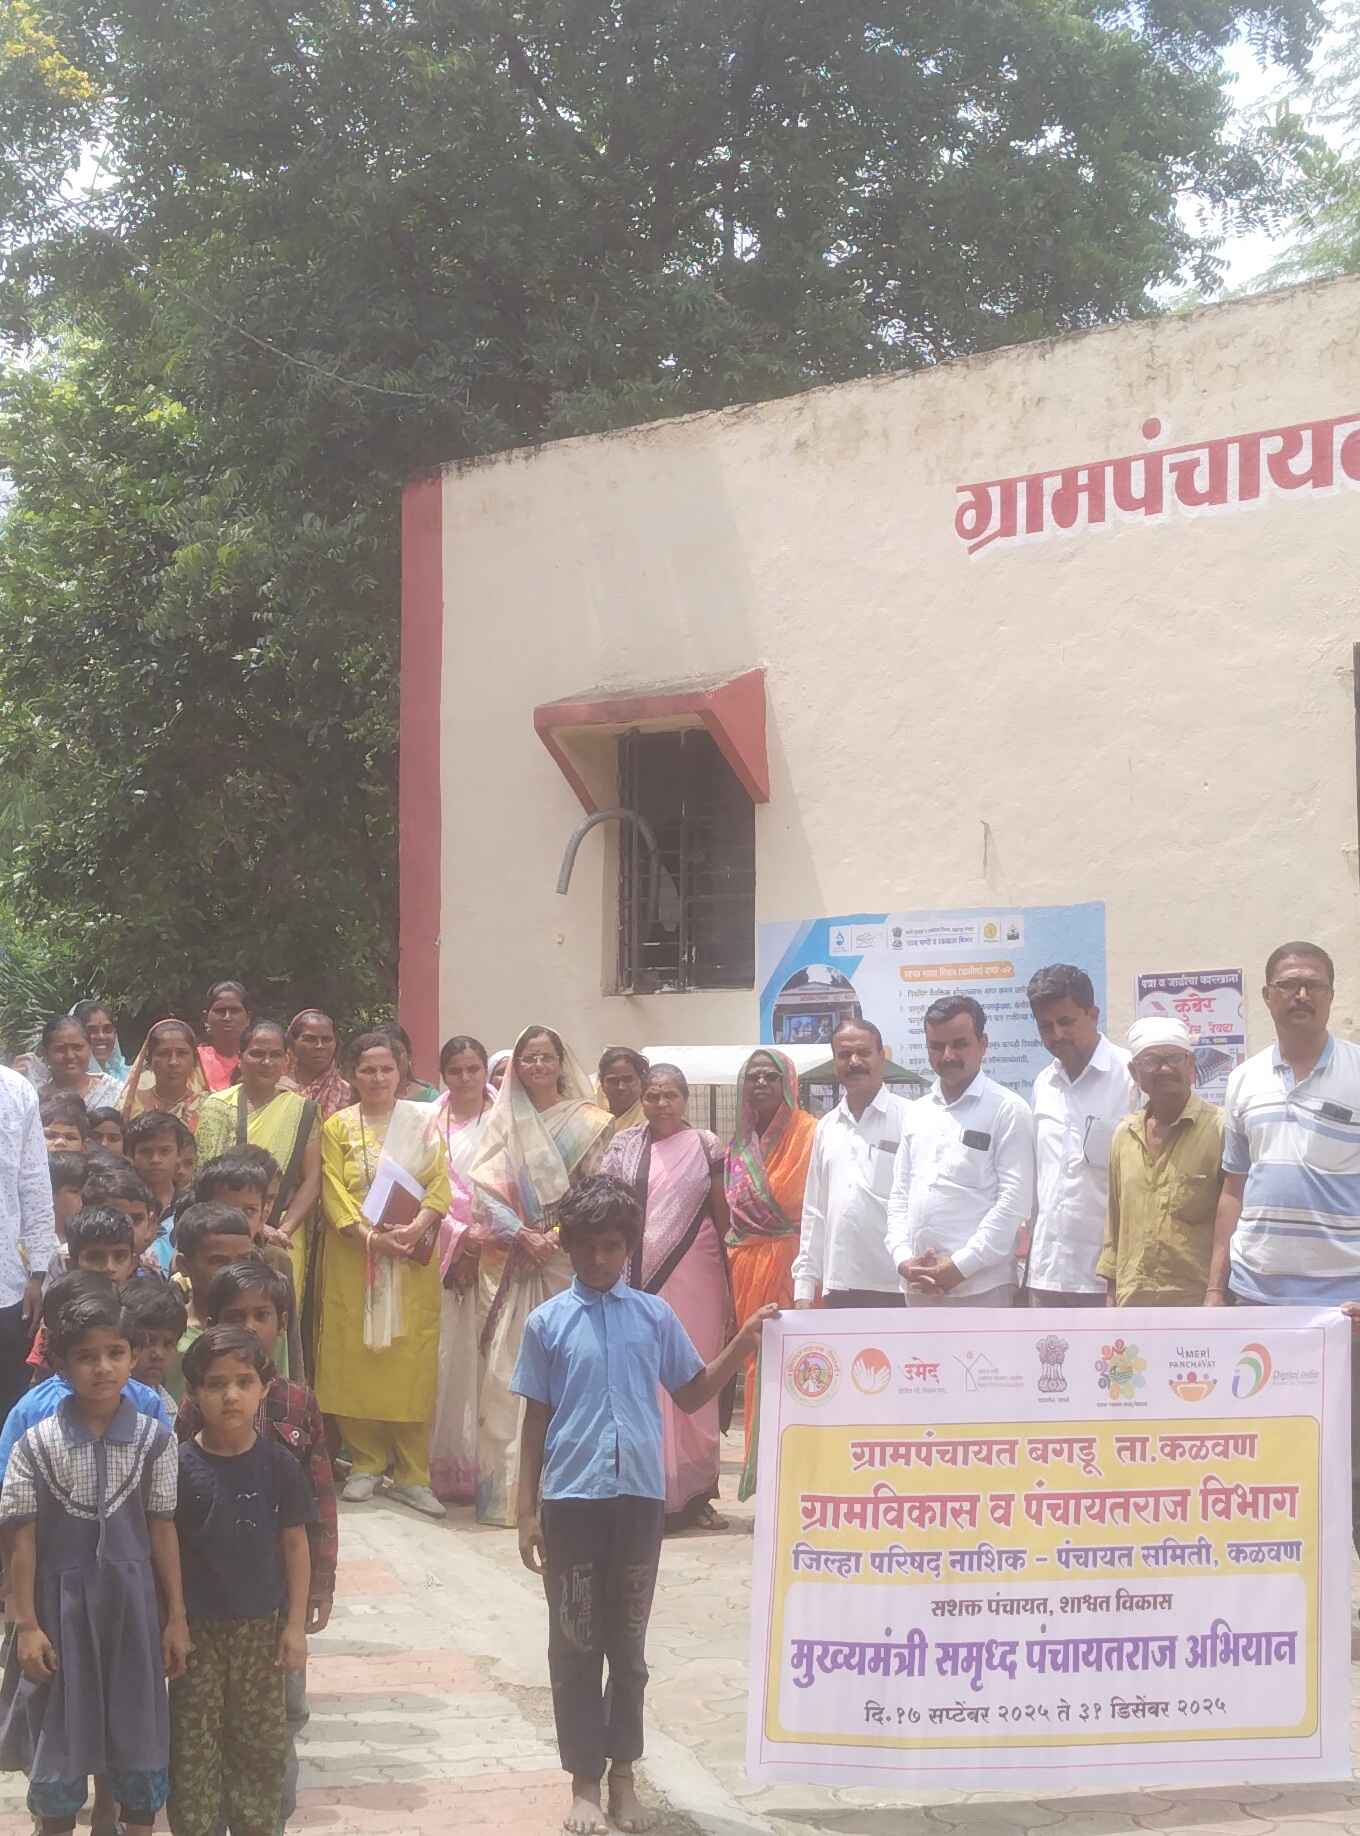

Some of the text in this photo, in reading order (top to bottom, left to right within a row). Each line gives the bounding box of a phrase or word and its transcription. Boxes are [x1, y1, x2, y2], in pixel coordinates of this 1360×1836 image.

[851, 1430, 1019, 1470] ग्रामपंचायत
[1027, 1436, 1103, 1476] बगडू
[801, 1475, 1299, 1530] ग्रामविकास व पंचायतराज विभाग
[792, 1542, 862, 1577] जिल्हा
[870, 1544, 942, 1578] परिषद
[949, 1542, 1028, 1573] नाशिक
[1057, 1539, 1134, 1568] पंचायत
[1141, 1536, 1219, 1568] समिती,
[1227, 1540, 1303, 1564] कळवण
[931, 1588, 1173, 1617] सशक्त पंचायत, शाश्वत विकास
[790, 1618, 1298, 1691] मुख्यमंत्री समृध्द पंचायतराज अभियान
[928, 1701, 991, 1725] सप्टेंबर
[998, 1703, 1050, 1722] २०२५
[1057, 1699, 1070, 1722] ते
[1078, 1702, 1102, 1721] ३१
[1111, 1695, 1169, 1720] डिसेंबर
[1177, 1697, 1227, 1717] २०२५
